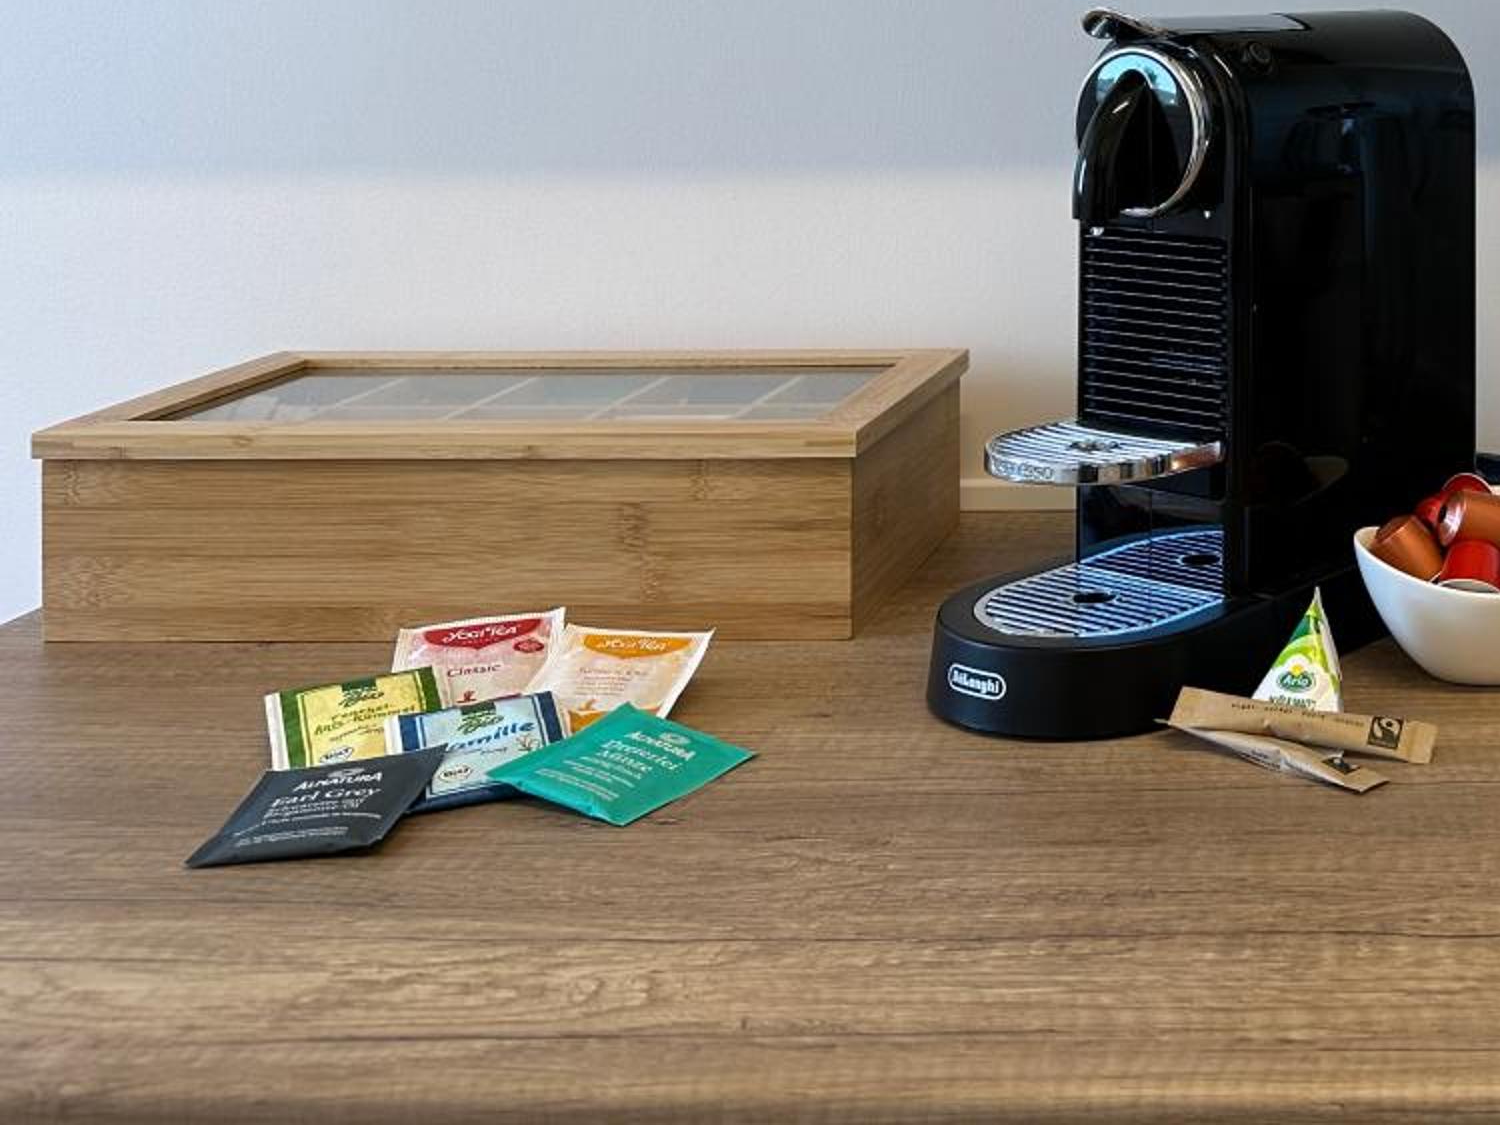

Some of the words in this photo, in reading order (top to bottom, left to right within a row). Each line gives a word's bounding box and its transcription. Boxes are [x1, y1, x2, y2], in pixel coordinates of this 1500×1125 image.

[447, 662, 502, 677] Classic
[271, 790, 321, 808] Earl
[324, 787, 383, 806] Grey
